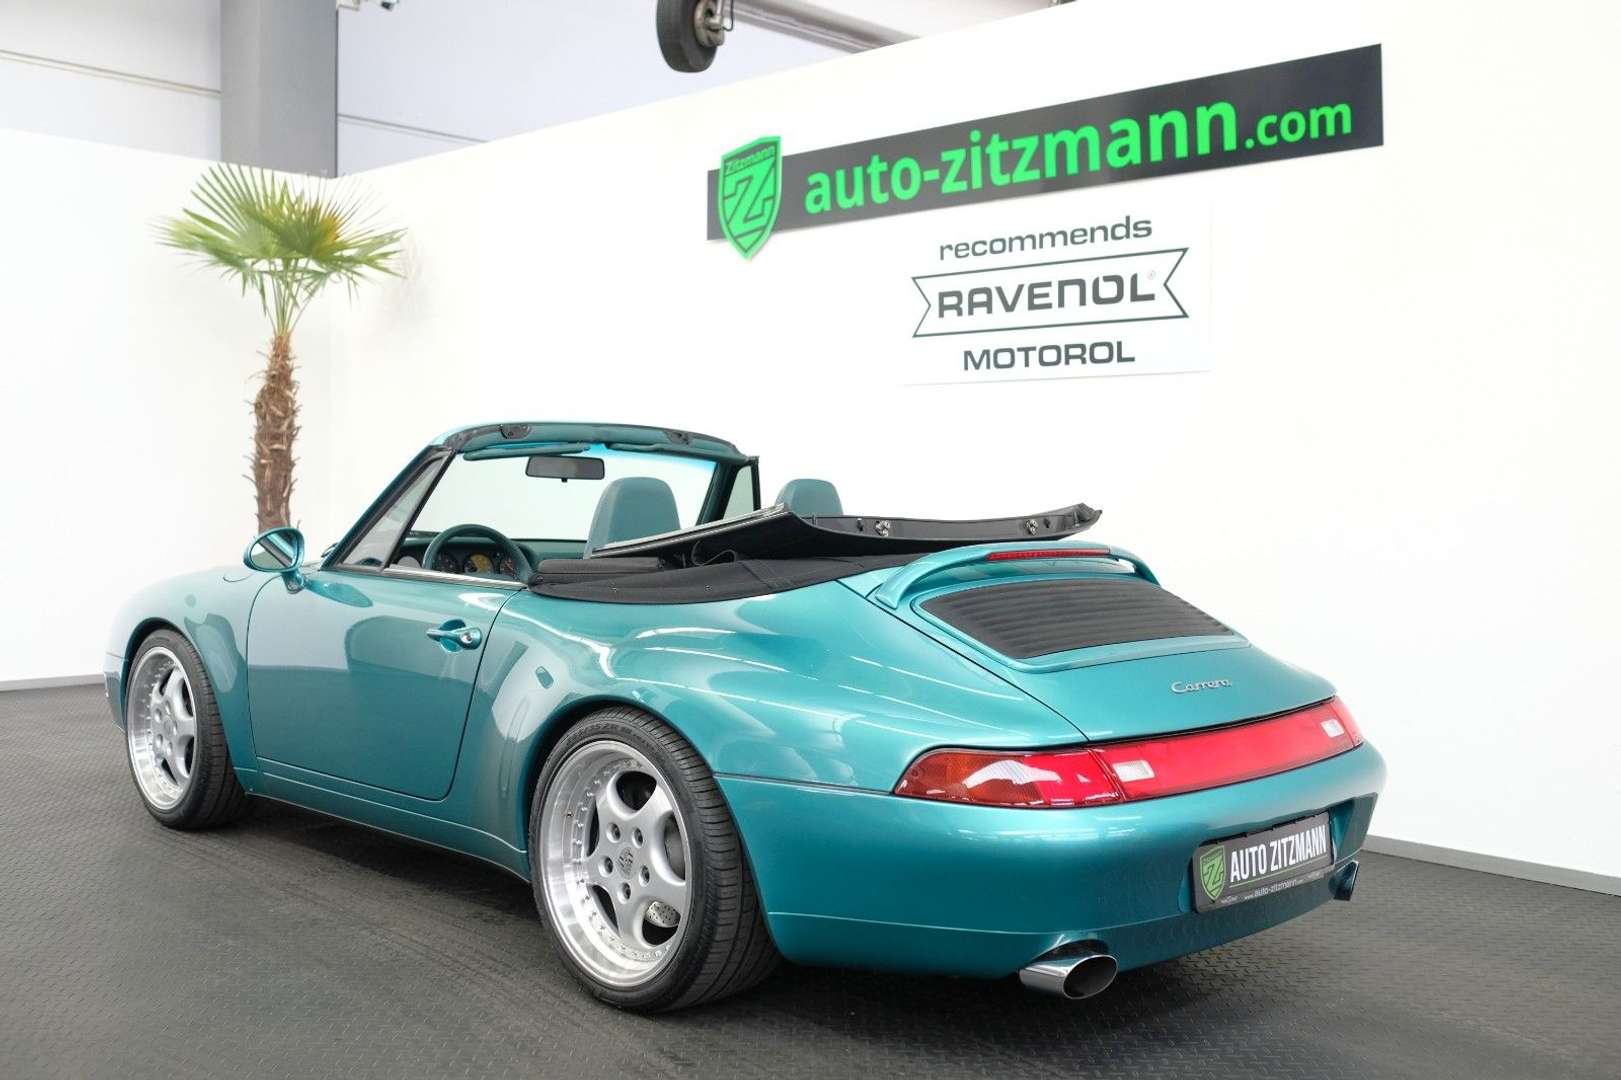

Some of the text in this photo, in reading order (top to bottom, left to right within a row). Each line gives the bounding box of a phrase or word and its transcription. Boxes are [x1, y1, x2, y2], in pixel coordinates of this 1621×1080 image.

[805, 101, 1352, 214] auto-zitzmann.com
[940, 215, 1152, 260] recommends
[938, 272, 1155, 318] RAVENOL
[963, 341, 1136, 371] MOTOROL
[1171, 679, 1232, 694] Carrera
[1230, 824, 1327, 883] AUTO ZITZMANN
